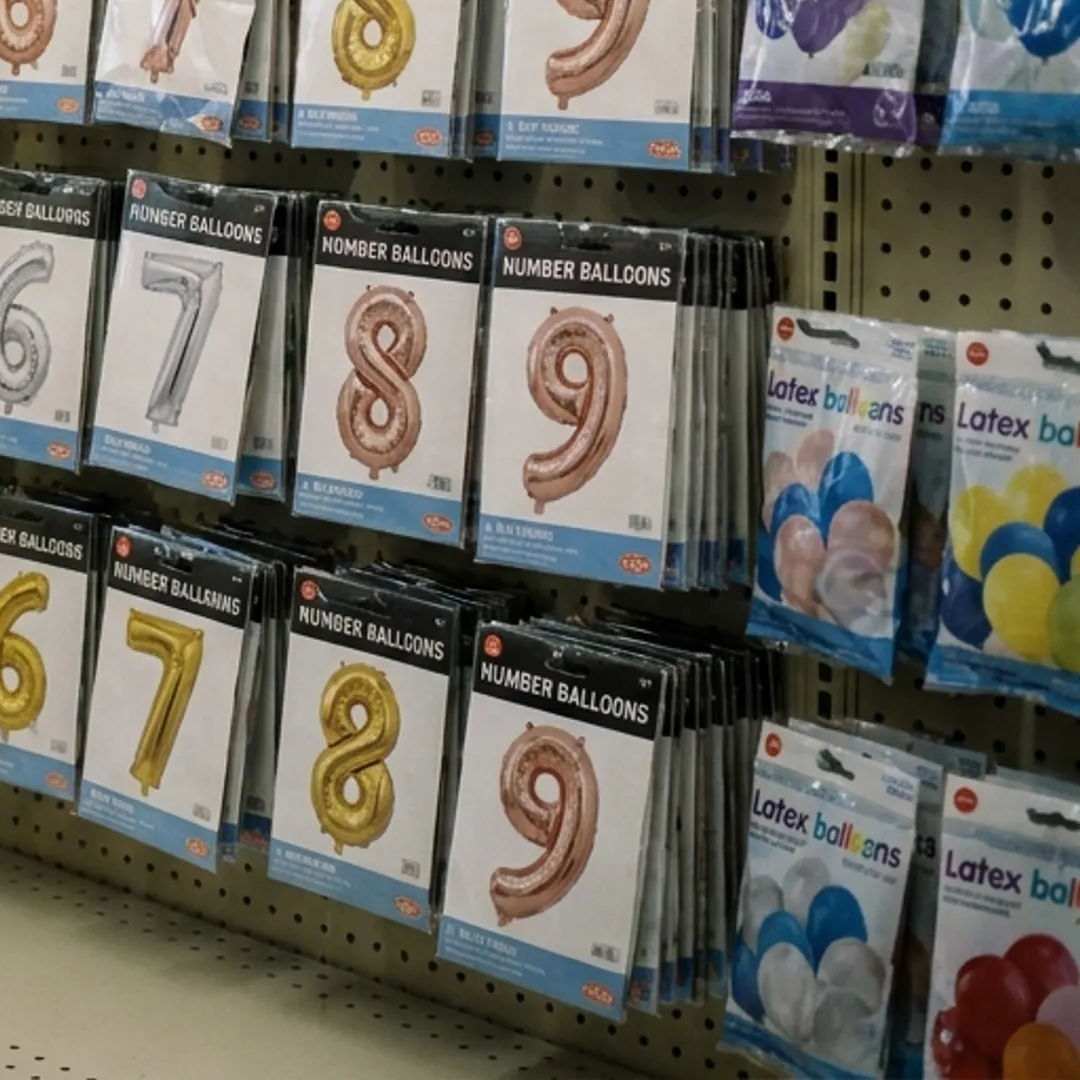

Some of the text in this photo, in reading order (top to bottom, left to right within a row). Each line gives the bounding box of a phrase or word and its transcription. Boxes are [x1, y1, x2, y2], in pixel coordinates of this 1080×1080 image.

[141, 251, 223, 433] 7
[503, 256, 671, 287] NUMBER BALLOONS
[337, 284, 427, 480] 8
[524, 307, 628, 515] 9
[957, 401, 1031, 439] Latex
[127, 608, 203, 797] 7
[311, 662, 401, 855] 8
[480, 662, 650, 725] NUMBER BALLOONS
[490, 721, 599, 927] 9
[752, 789, 809, 834] Latex
[945, 849, 1023, 895] Latex
